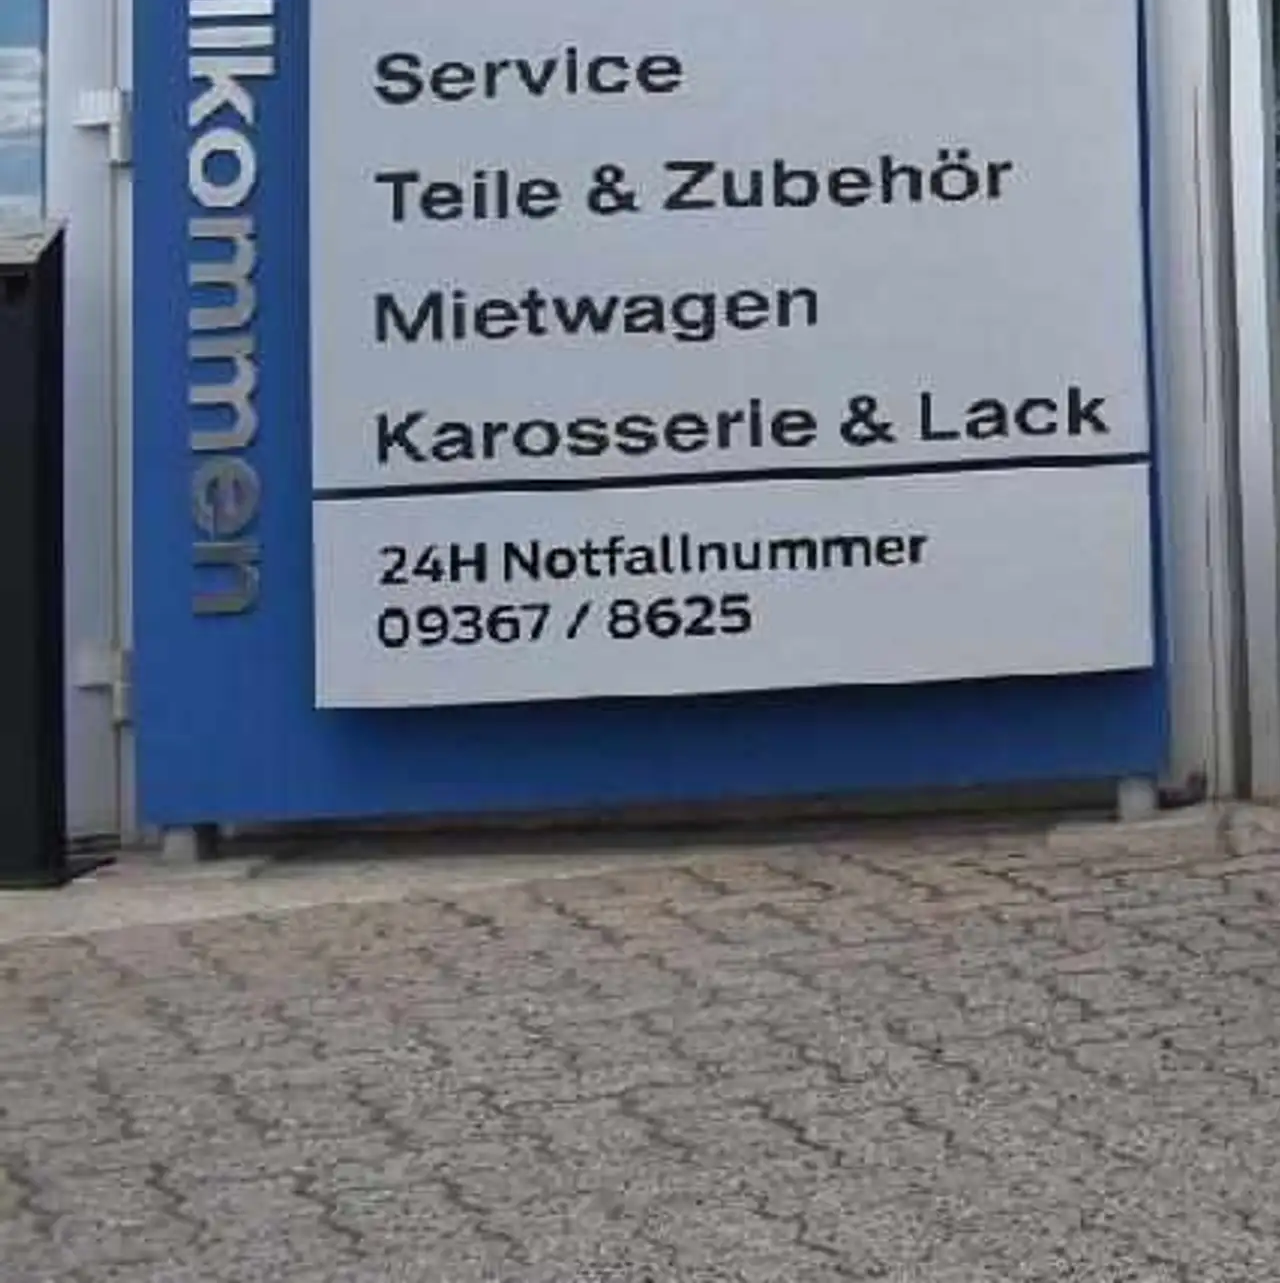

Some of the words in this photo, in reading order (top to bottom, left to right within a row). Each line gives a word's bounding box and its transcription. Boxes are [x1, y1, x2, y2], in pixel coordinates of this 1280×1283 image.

[374, 46, 684, 107] Service
[374, 168, 562, 224] Teile
[586, 164, 640, 216] &
[662, 148, 1014, 212] Zubehör
[375, 282, 819, 344] Mietwagen
[376, 397, 820, 465] Karosserie
[839, 394, 897, 447] &
[919, 385, 1110, 442] Lack
[379, 542, 488, 586] 24H
[502, 532, 929, 584] Notfallnummer
[377, 602, 552, 649] 09367
[565, 601, 592, 641] /
[606, 592, 753, 641] 8625
